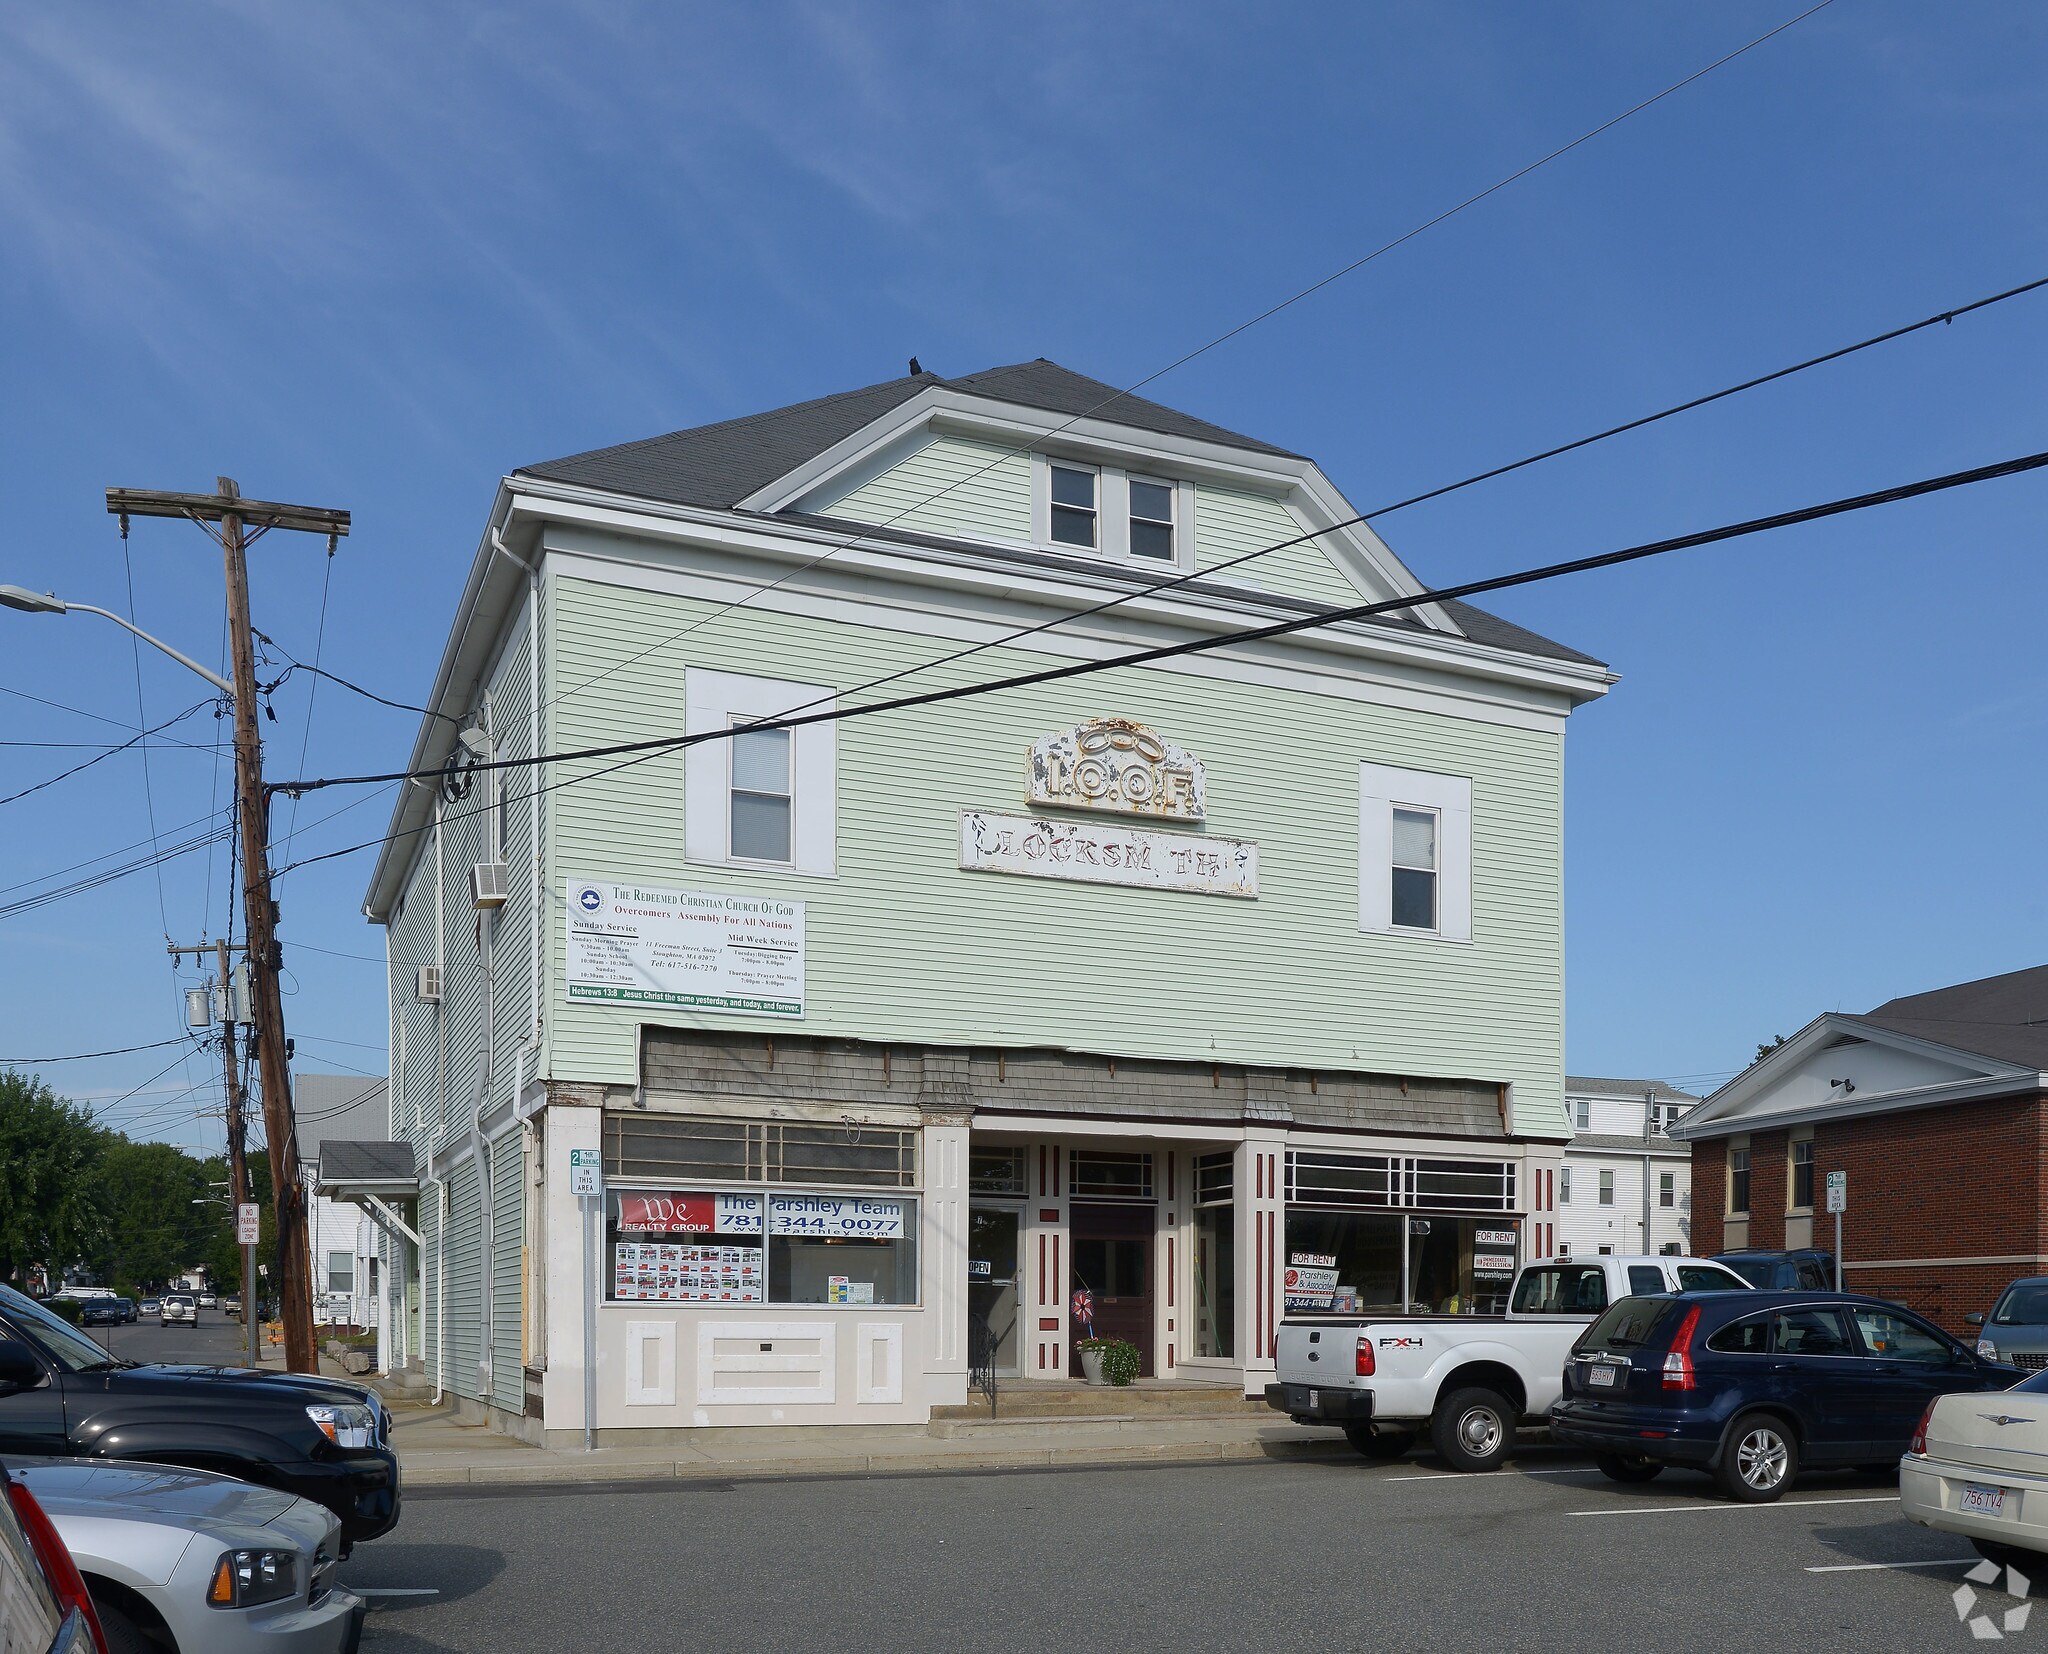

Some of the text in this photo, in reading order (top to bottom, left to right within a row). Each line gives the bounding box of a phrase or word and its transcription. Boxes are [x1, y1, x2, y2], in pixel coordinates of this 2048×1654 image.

[1000, 830, 1219, 879] LOCKSMTH
[614, 905, 793, 930] Overcomers Assembly For All Nations
[573, 920, 638, 933] Sunday Service
[594, 937, 619, 946] Morning
[728, 933, 799, 947] Mid Week Service
[586, 951, 607, 959] Sunday
[702, 946, 718, 954] Suite
[595, 966, 616, 974] Sunday
[651, 959, 718, 972] Tel: 617-516-7270
[571, 986, 800, 1012] Hebrews 13:8 Jesus Christ the same yesterday, and today, and forever.
[572, 1152, 579, 1164] 2
[1828, 1175, 1833, 1186] 2
[720, 1194, 900, 1217] The Parshley Team
[246, 1208, 253, 1216] NO
[625, 1223, 710, 1232] REALTY GROUP
[719, 1214, 899, 1231] 781-344-0077
[1477, 1231, 1515, 1242] FOR RENT
[1292, 1253, 1335, 1265] FOR RENT
[968, 1261, 989, 1273] OPEN
[1300, 1270, 1335, 1282] Parshley
[1474, 1271, 1513, 1280] www.parshley.com
[1298, 1280, 1335, 1291] & Associates
[1379, 1337, 1423, 1347] FX4
[1964, 1490, 1984, 1506] 756
